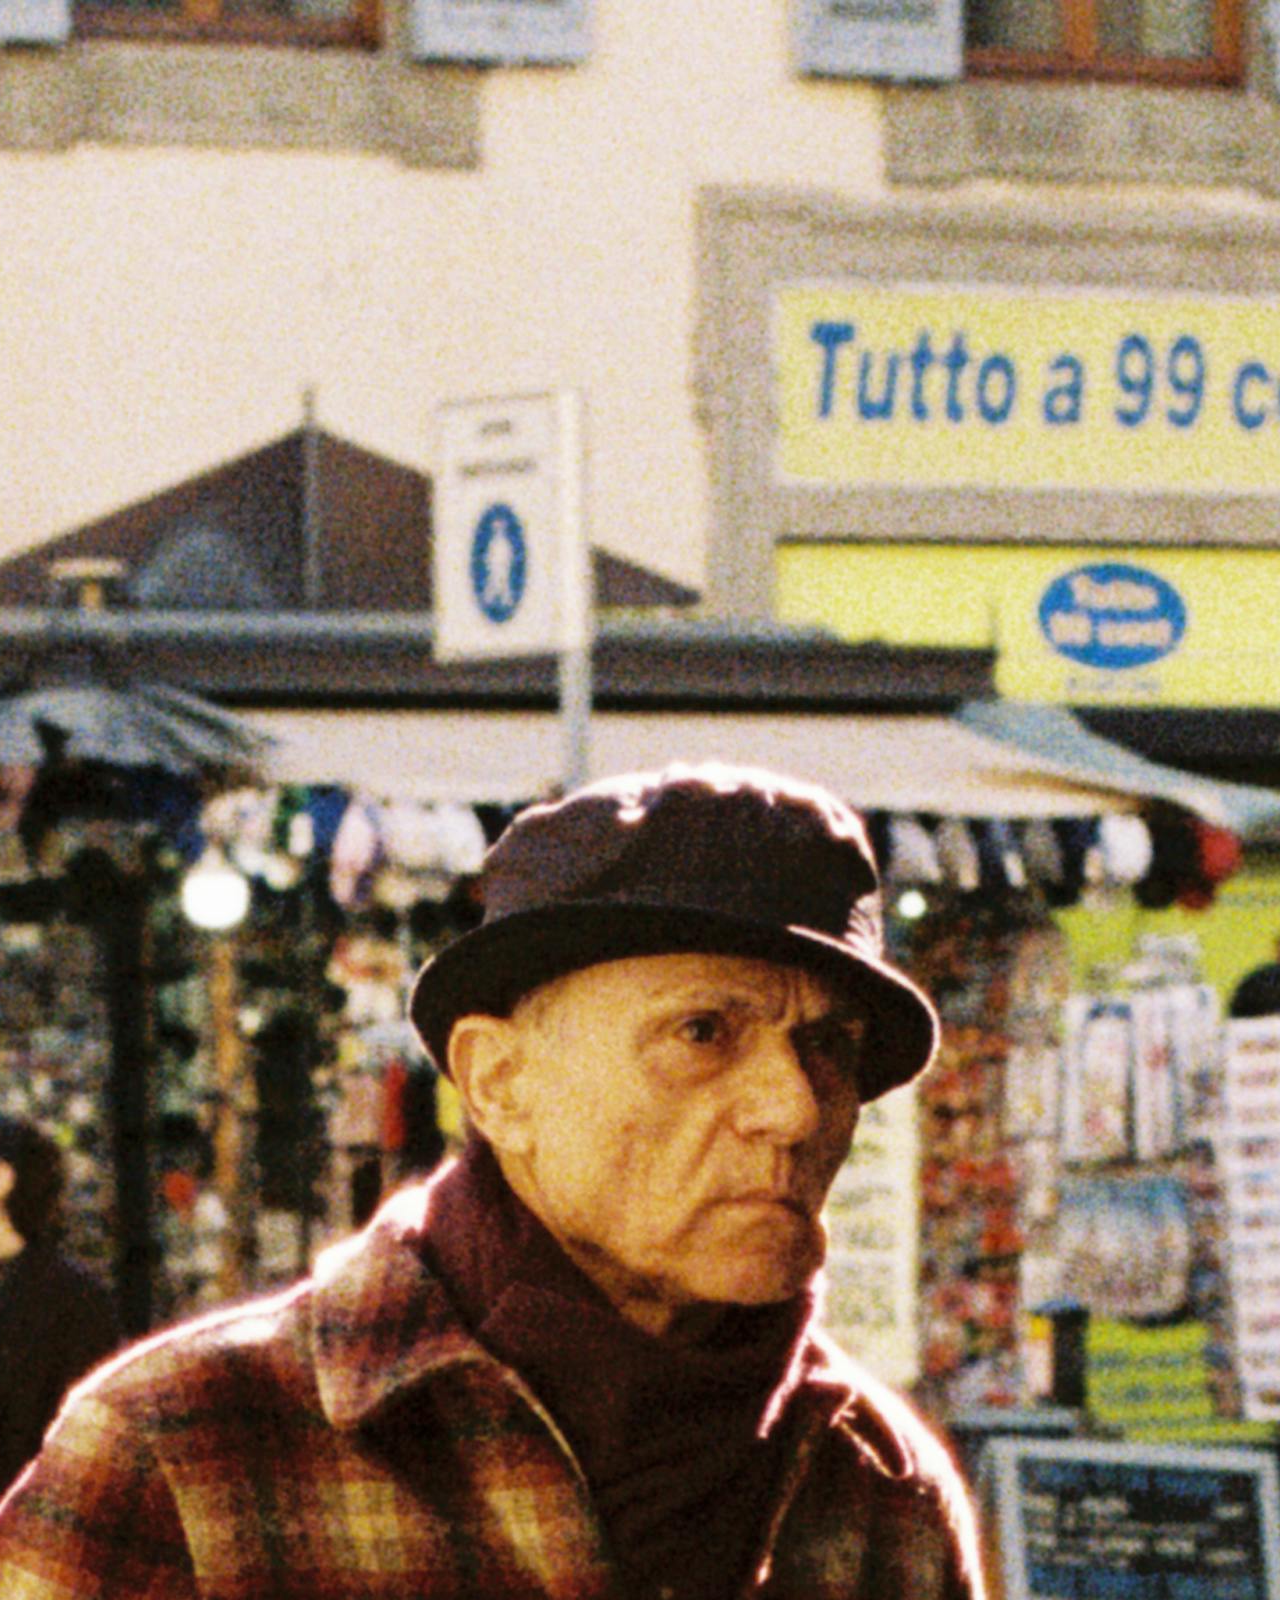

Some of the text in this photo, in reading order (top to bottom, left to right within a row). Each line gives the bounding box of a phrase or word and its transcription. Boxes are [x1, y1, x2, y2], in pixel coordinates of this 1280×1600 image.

[810, 320, 1018, 425] Tutto
[1041, 350, 1085, 425] a
[1113, 332, 1207, 429] 99
